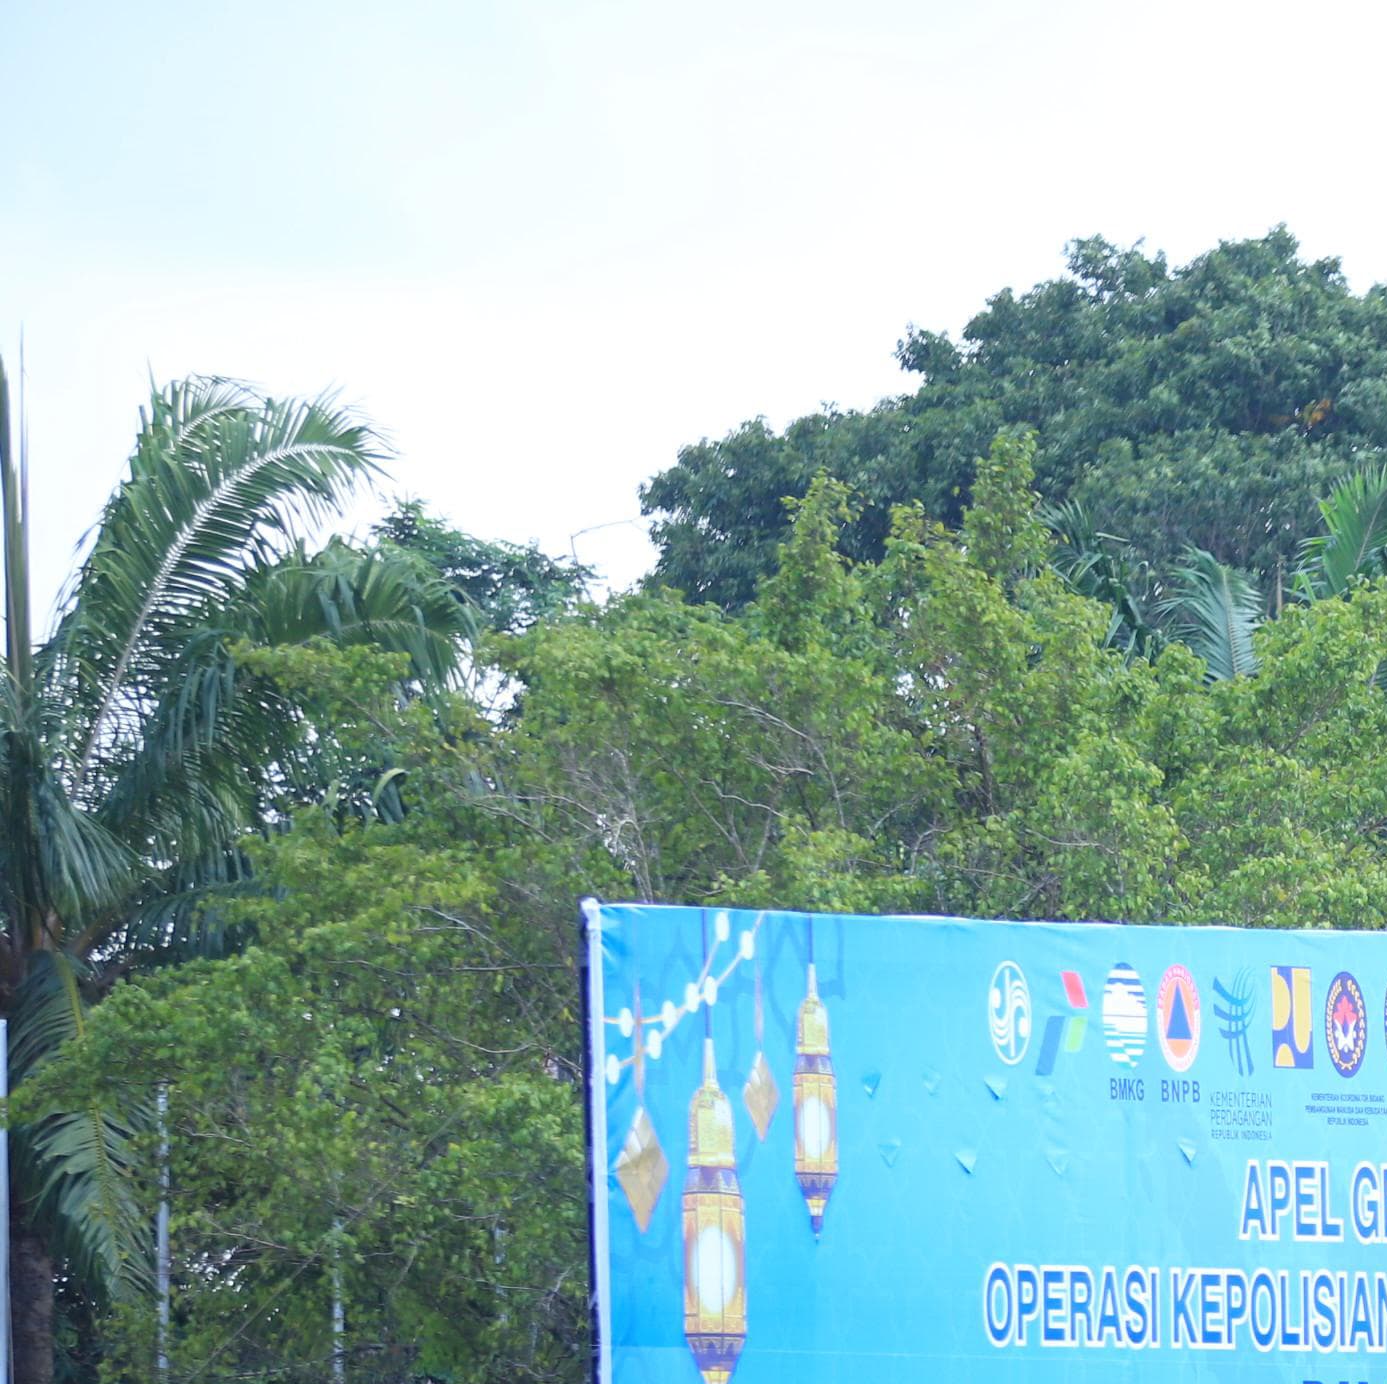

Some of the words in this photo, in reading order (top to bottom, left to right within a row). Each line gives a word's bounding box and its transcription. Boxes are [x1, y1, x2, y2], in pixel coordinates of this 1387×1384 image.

[1110, 1077, 1145, 1101] BMKG
[1161, 1079, 1201, 1103] BNPB
[1210, 1091, 1273, 1108] KEMENTERIAN
[1210, 1109, 1273, 1126] PERDAGANGAN
[1211, 1129, 1239, 1140] REPUBLIK
[1241, 1129, 1273, 1141] INDONESIA
[1239, 1159, 1344, 1242] APEL
[984, 1264, 1160, 1348] OPERASI
